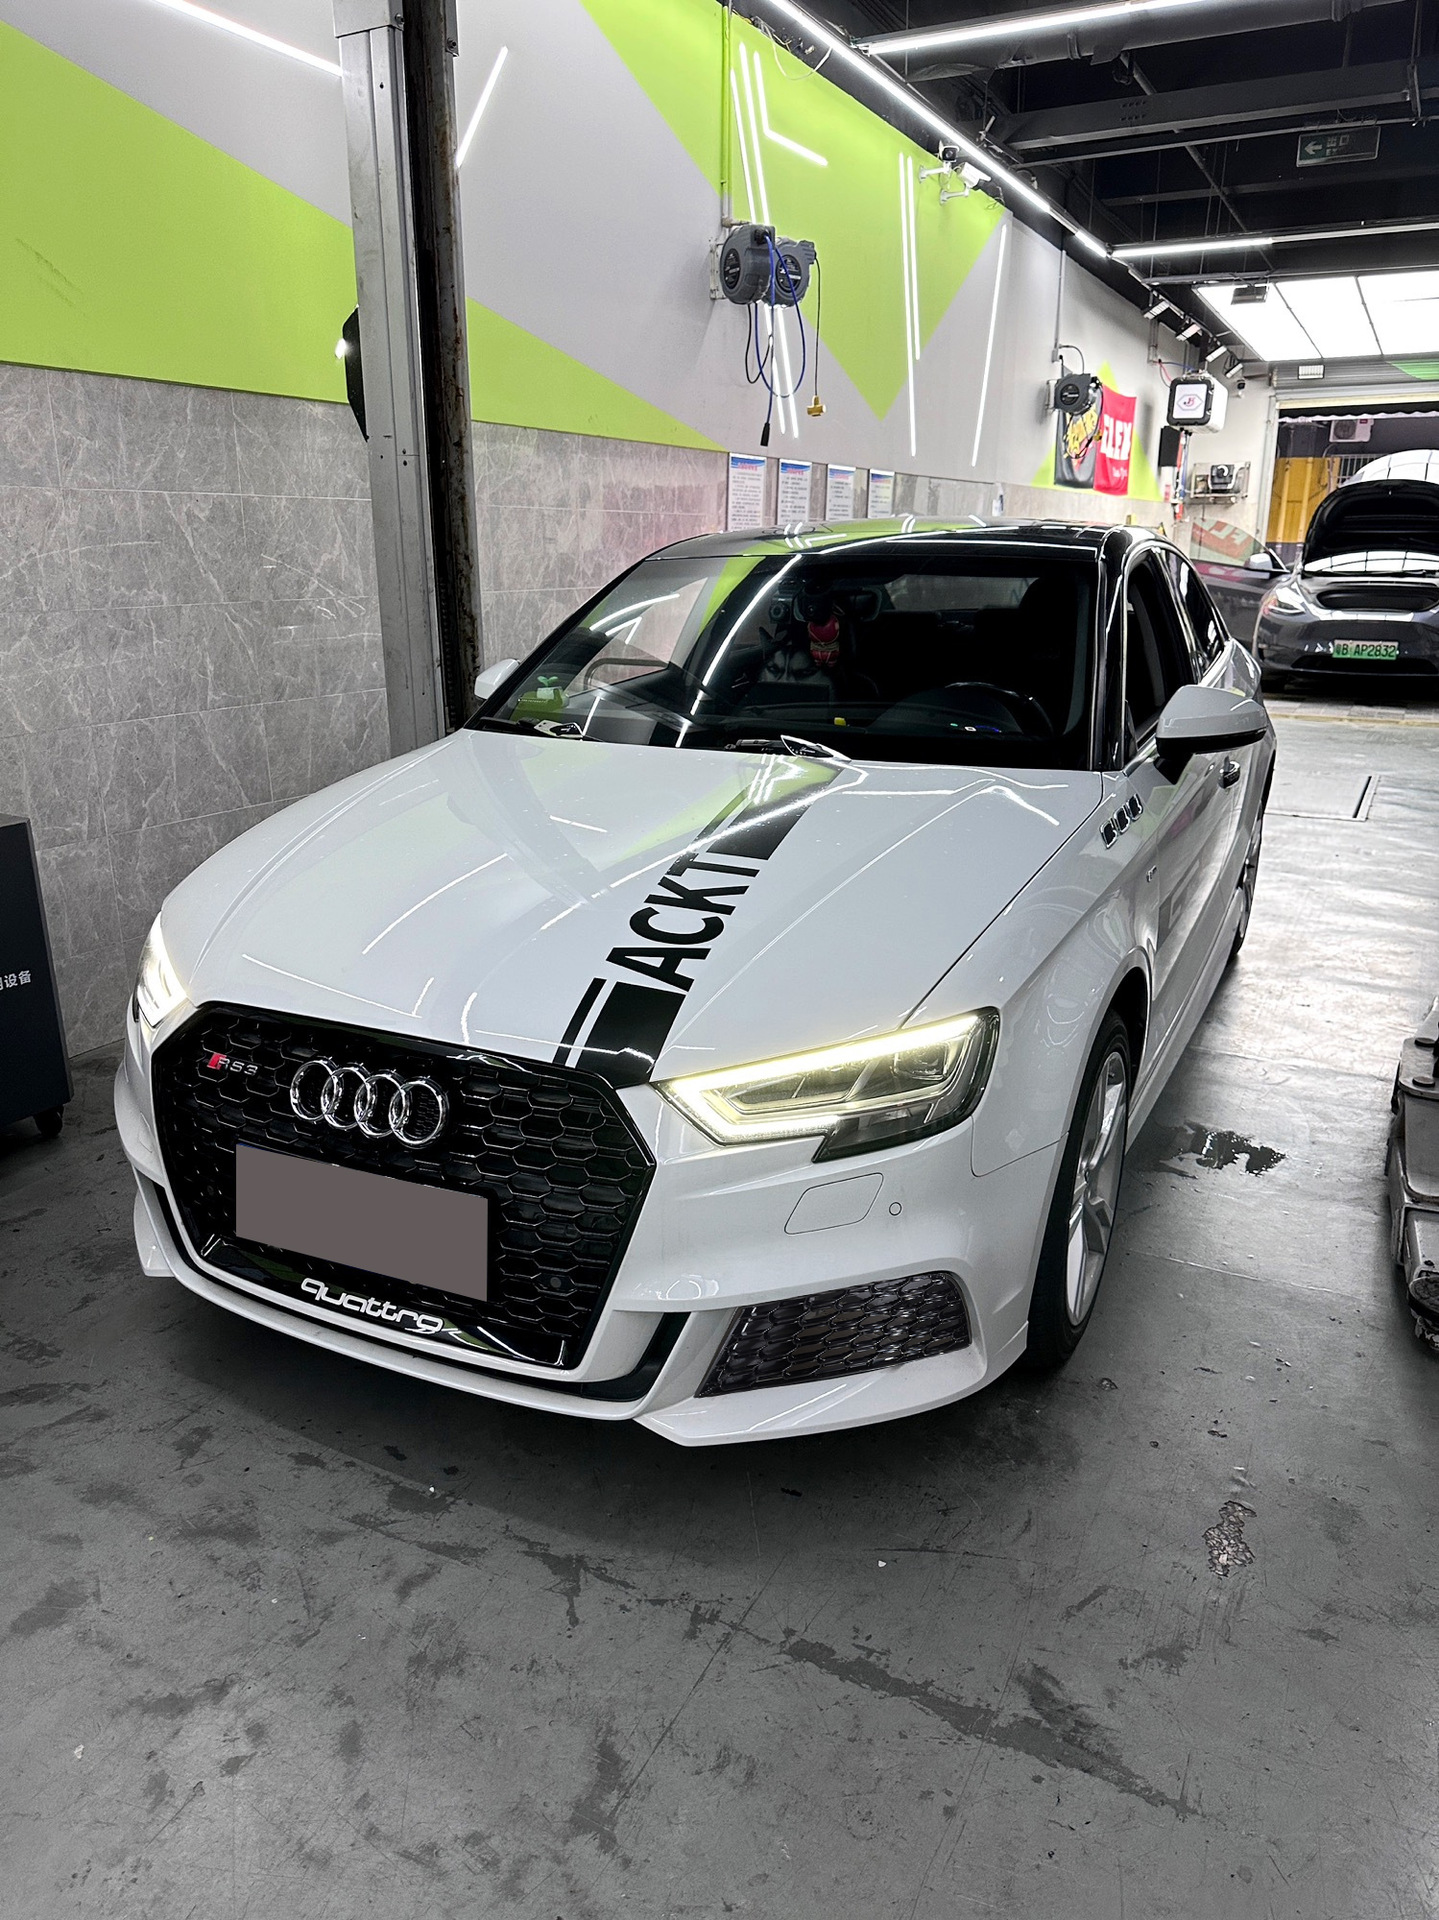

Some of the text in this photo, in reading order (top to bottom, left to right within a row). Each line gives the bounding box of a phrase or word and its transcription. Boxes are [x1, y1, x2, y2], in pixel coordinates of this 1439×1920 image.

[1100, 413, 1132, 460] FLEX
[216, 1055, 259, 1076] RS3
[301, 1277, 444, 1333] quattro
